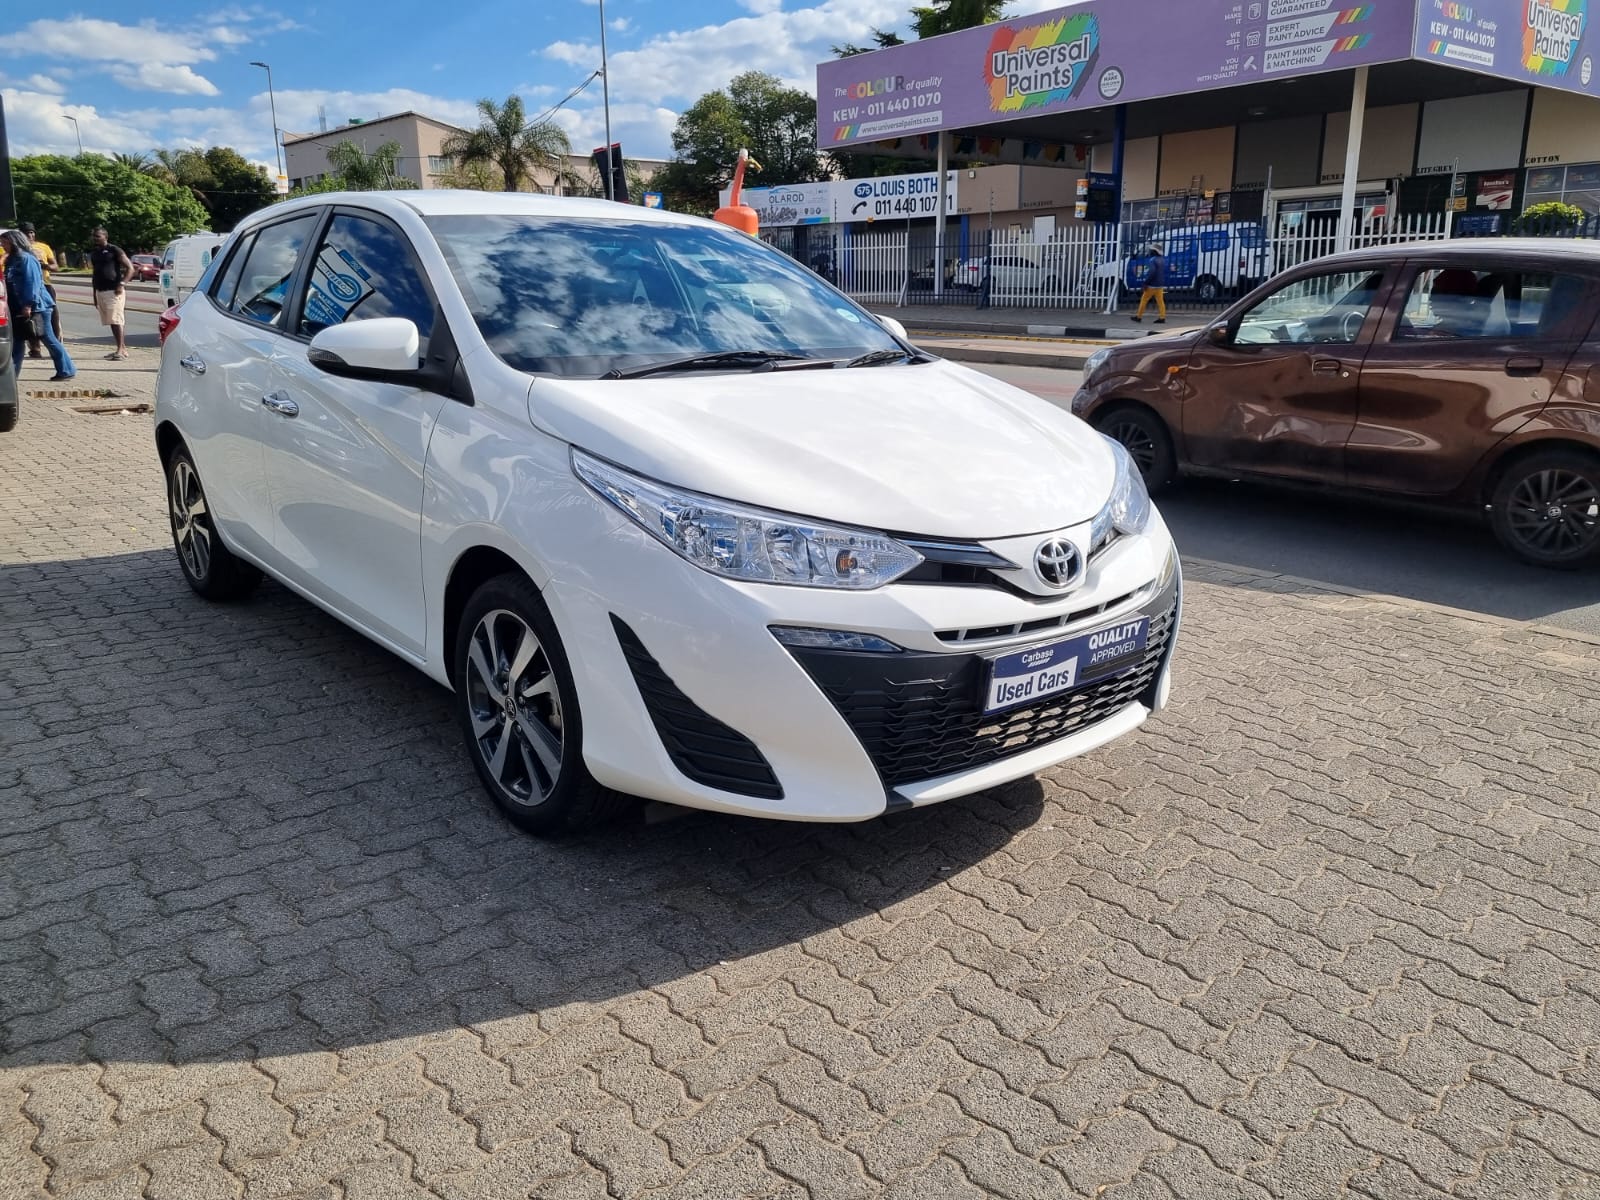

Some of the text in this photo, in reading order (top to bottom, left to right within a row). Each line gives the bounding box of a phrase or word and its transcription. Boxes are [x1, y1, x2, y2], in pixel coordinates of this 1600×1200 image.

[1270, 0, 1327, 16] GUARANTEED
[1269, 23, 1300, 35] EXPERT
[1529, 0, 1582, 38] Universal
[1268, 26, 1325, 42] PAINT ADVICE
[1430, 21, 1449, 37] KEW
[1453, 27, 1464, 40] 011
[1465, 30, 1478, 44] 440
[1479, 33, 1496, 48] 1070
[1534, 29, 1570, 60] Paints
[993, 36, 1089, 76] Universal
[1266, 45, 1323, 62] PAINT MIXING
[1273, 55, 1316, 68] MATCHING
[1007, 65, 1072, 96] Paints
[1213, 70, 1239, 81] QUALITY
[834, 75, 942, 100] The COLOUR of quality
[833, 106, 859, 122] KEW
[867, 101, 885, 116] 011
[887, 97, 910, 113] 440
[912, 92, 942, 108] 1070
[1525, 155, 1560, 164] COTTON
[856, 177, 938, 197] 575 LOUIS BOTH
[875, 200, 891, 215] 011
[894, 197, 917, 213] 440
[1088, 621, 1142, 650] QUALITY
[1022, 649, 1054, 664] Carbase
[1090, 641, 1136, 664] APPROVED
[996, 670, 1070, 703] Used Cars
